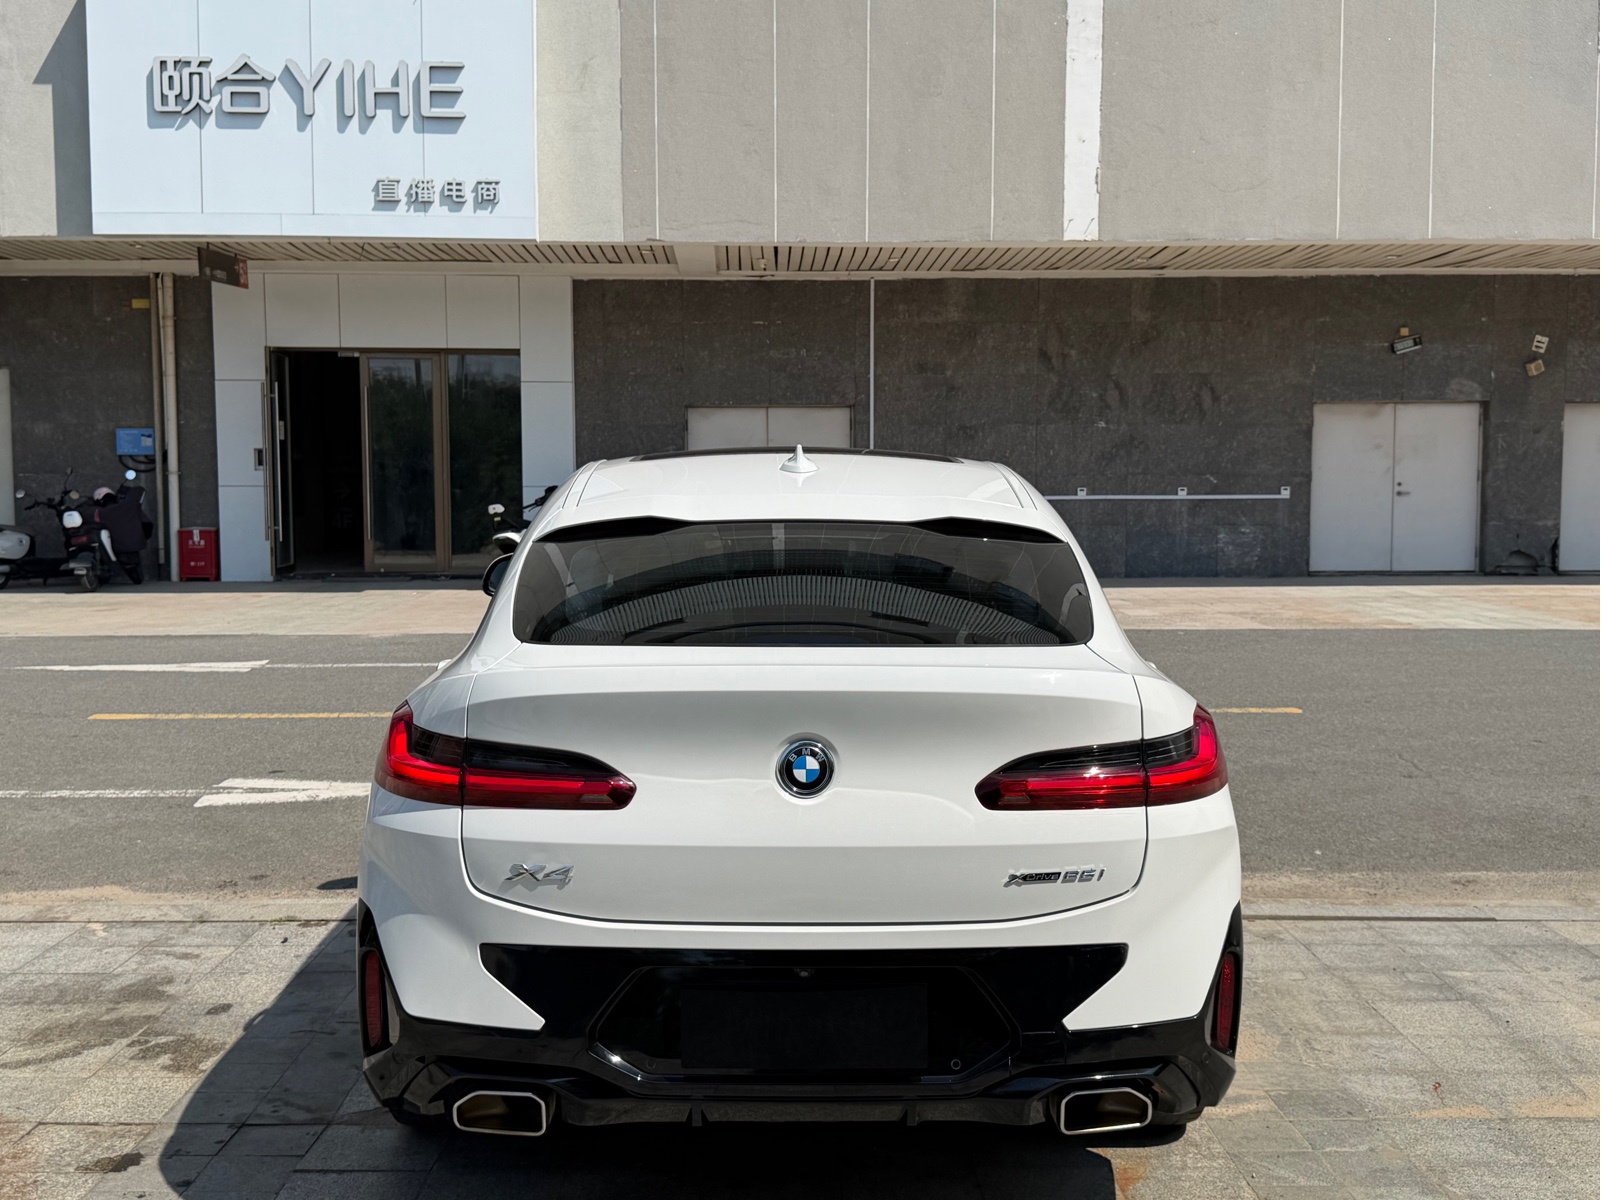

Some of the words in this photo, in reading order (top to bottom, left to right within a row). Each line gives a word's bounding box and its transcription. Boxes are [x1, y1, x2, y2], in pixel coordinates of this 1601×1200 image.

[375, 176, 502, 204] 直播电商
[788, 747, 825, 762] BMW
[502, 863, 575, 888] X4
